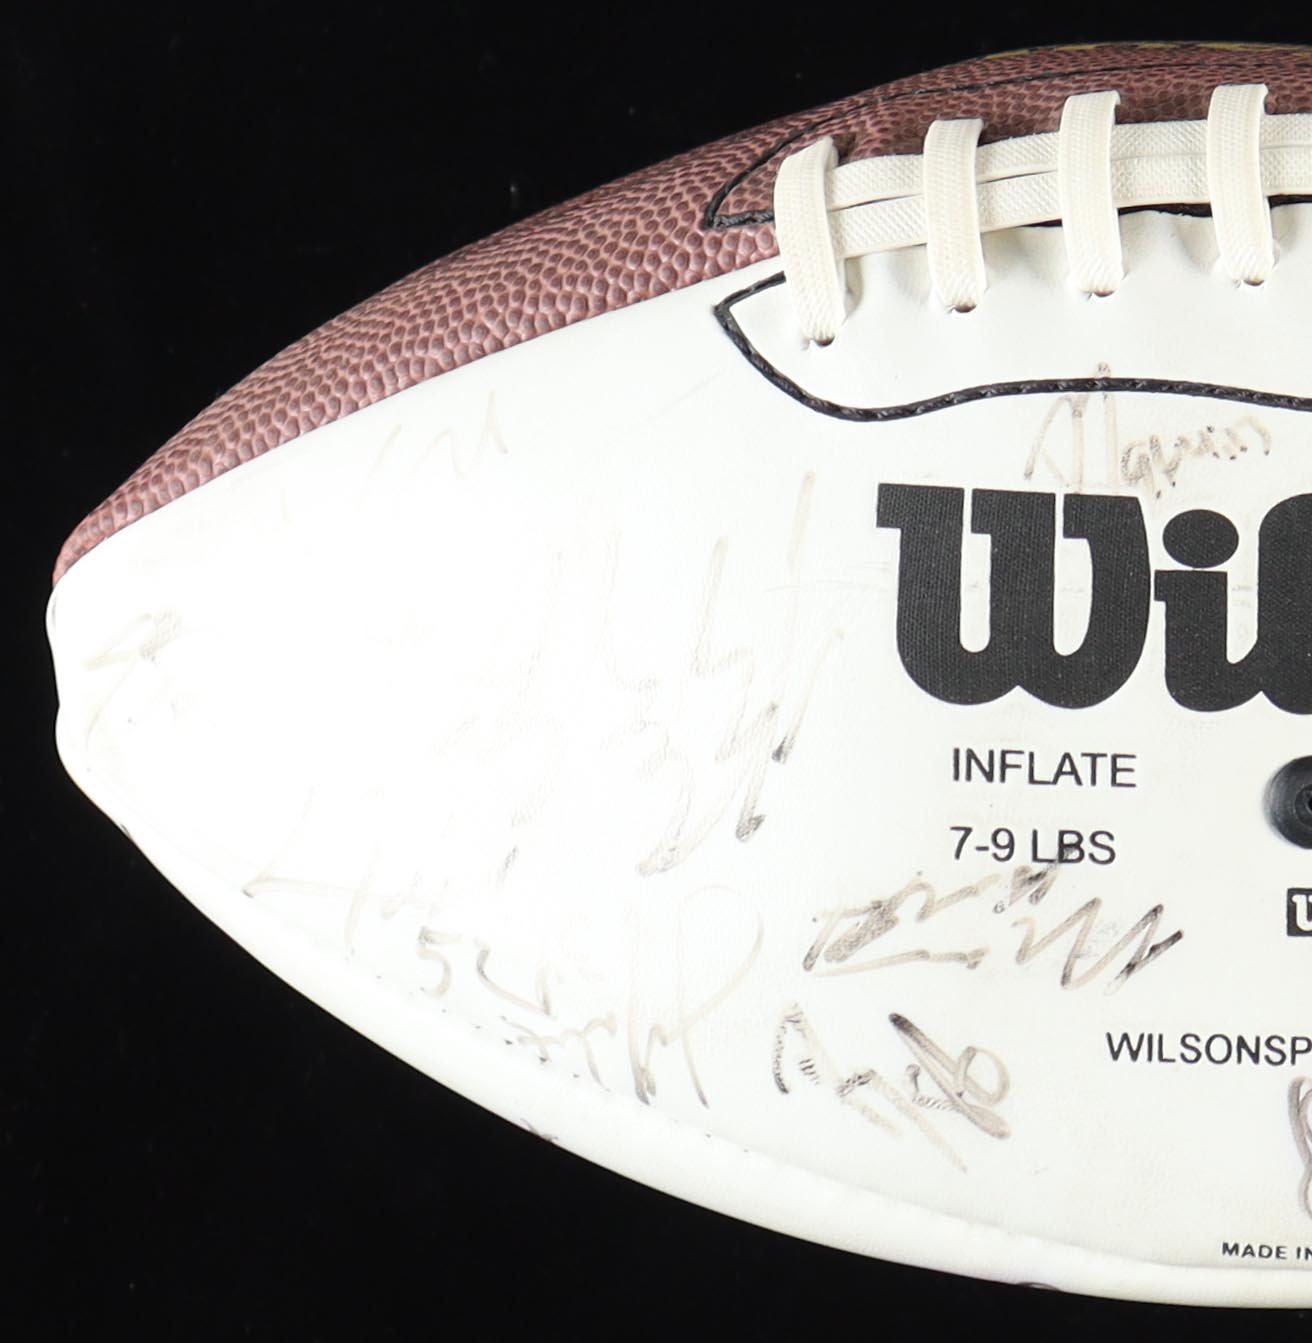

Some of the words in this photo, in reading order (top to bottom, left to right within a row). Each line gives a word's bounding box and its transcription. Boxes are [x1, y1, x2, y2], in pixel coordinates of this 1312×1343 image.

[953, 748, 1136, 788] INFLATE
[951, 826, 1015, 861] 7-9
[1032, 828, 1116, 865] LBS
[1221, 1241, 1289, 1261] MADE
